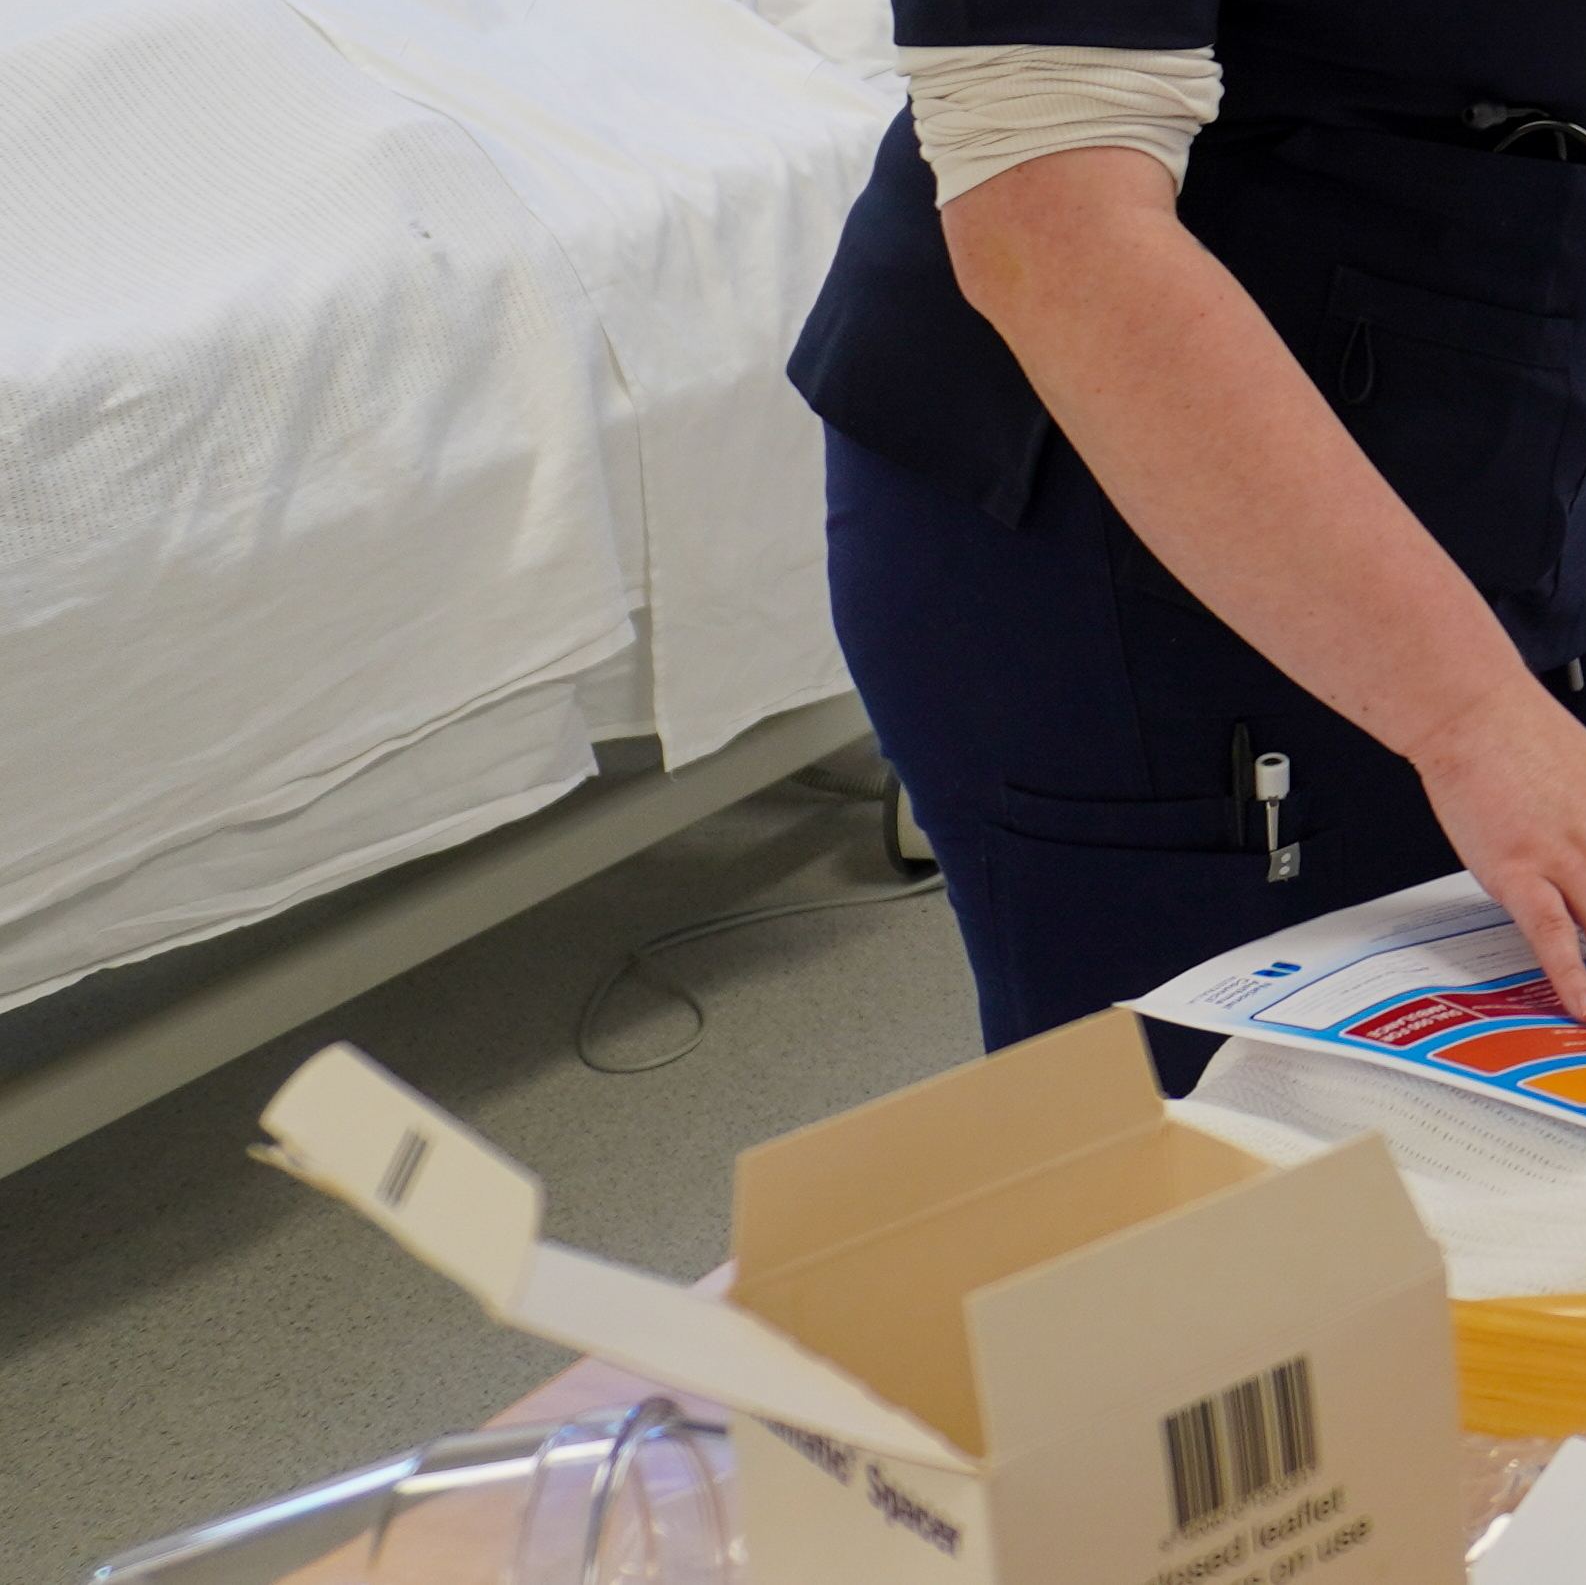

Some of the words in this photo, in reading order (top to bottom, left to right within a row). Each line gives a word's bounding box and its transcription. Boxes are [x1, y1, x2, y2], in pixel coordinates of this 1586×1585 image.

[1365, 1003, 1448, 1039] AMBULANCE
[864, 1461, 963, 1561] Spacer
[1251, 1483, 1347, 1555] leaflet
[1316, 1513, 1374, 1564] use
